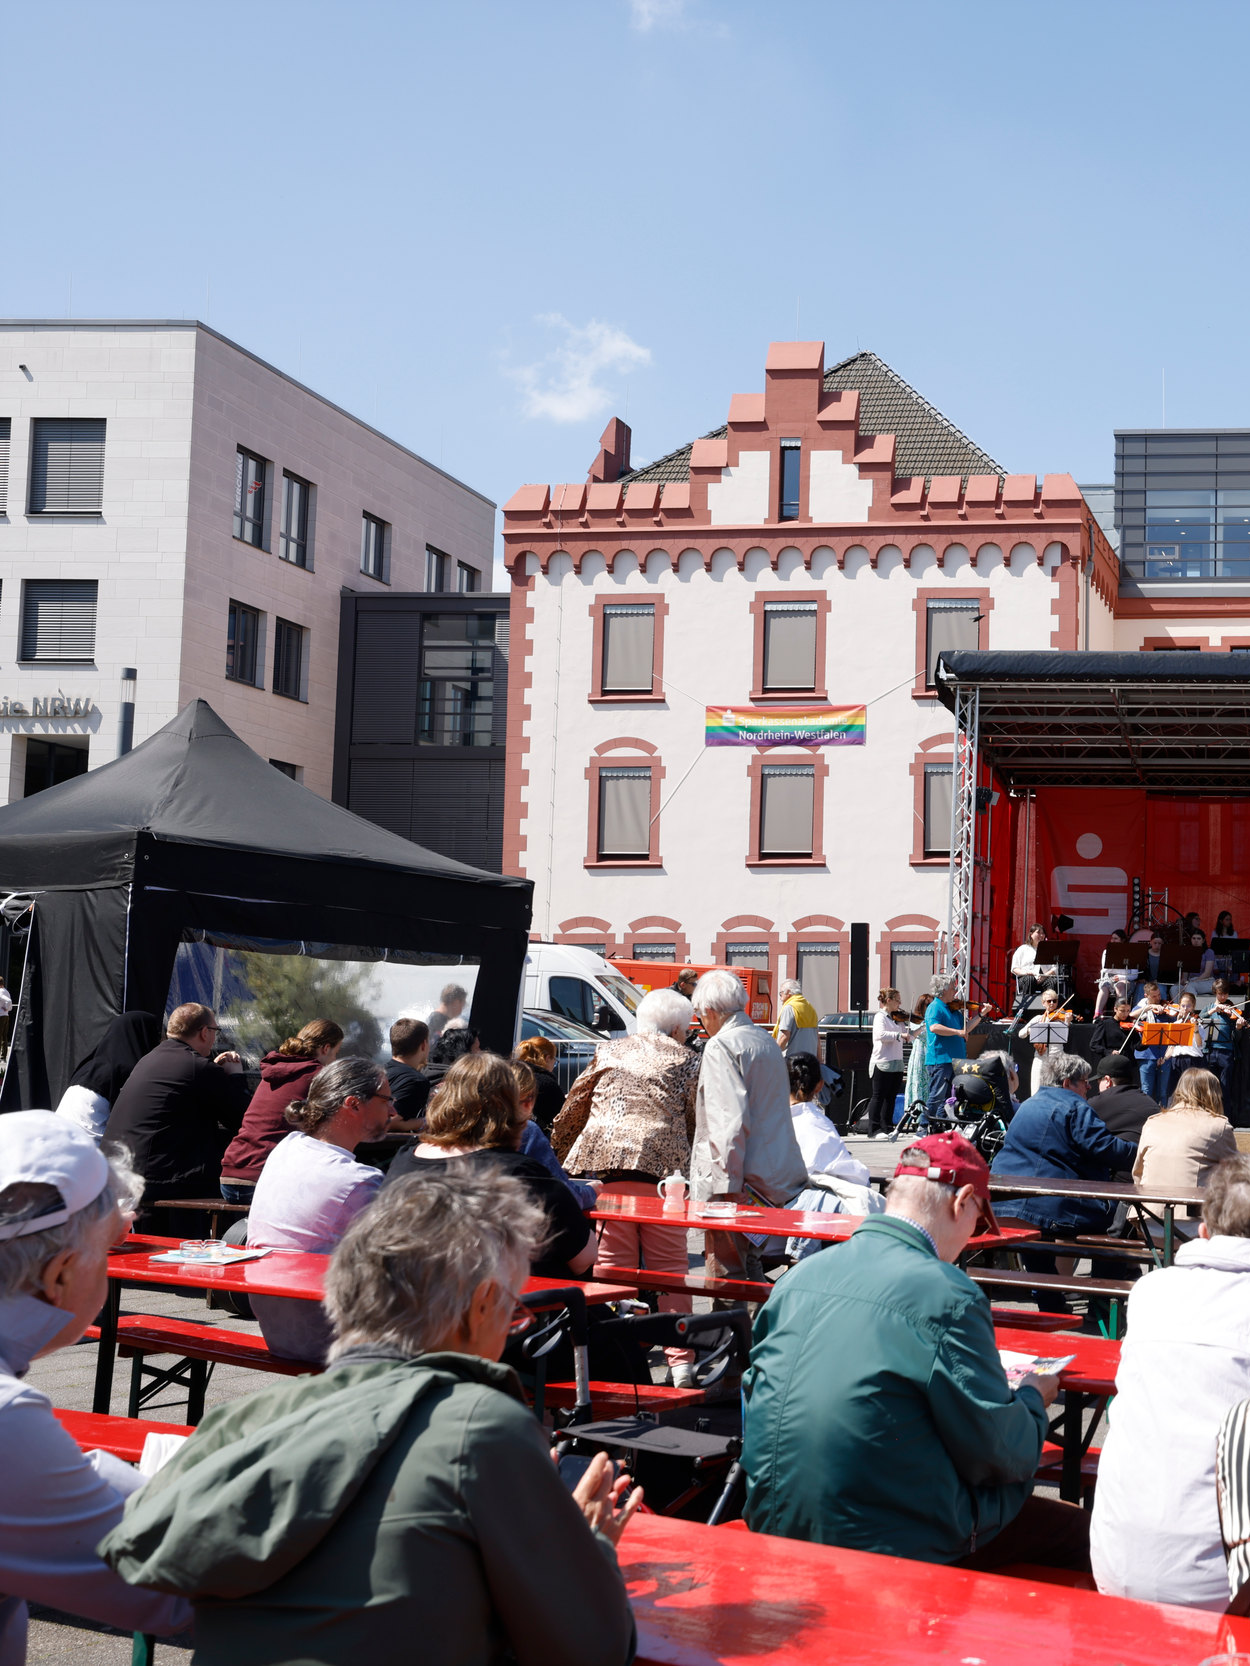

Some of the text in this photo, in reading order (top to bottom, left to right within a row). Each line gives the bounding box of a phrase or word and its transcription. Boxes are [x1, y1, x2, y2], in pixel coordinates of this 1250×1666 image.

[0, 695, 91, 717] ie NRW
[739, 715, 848, 728] Sparkassenakademie
[738, 729, 847, 740] Nordrhein-Westfalen
